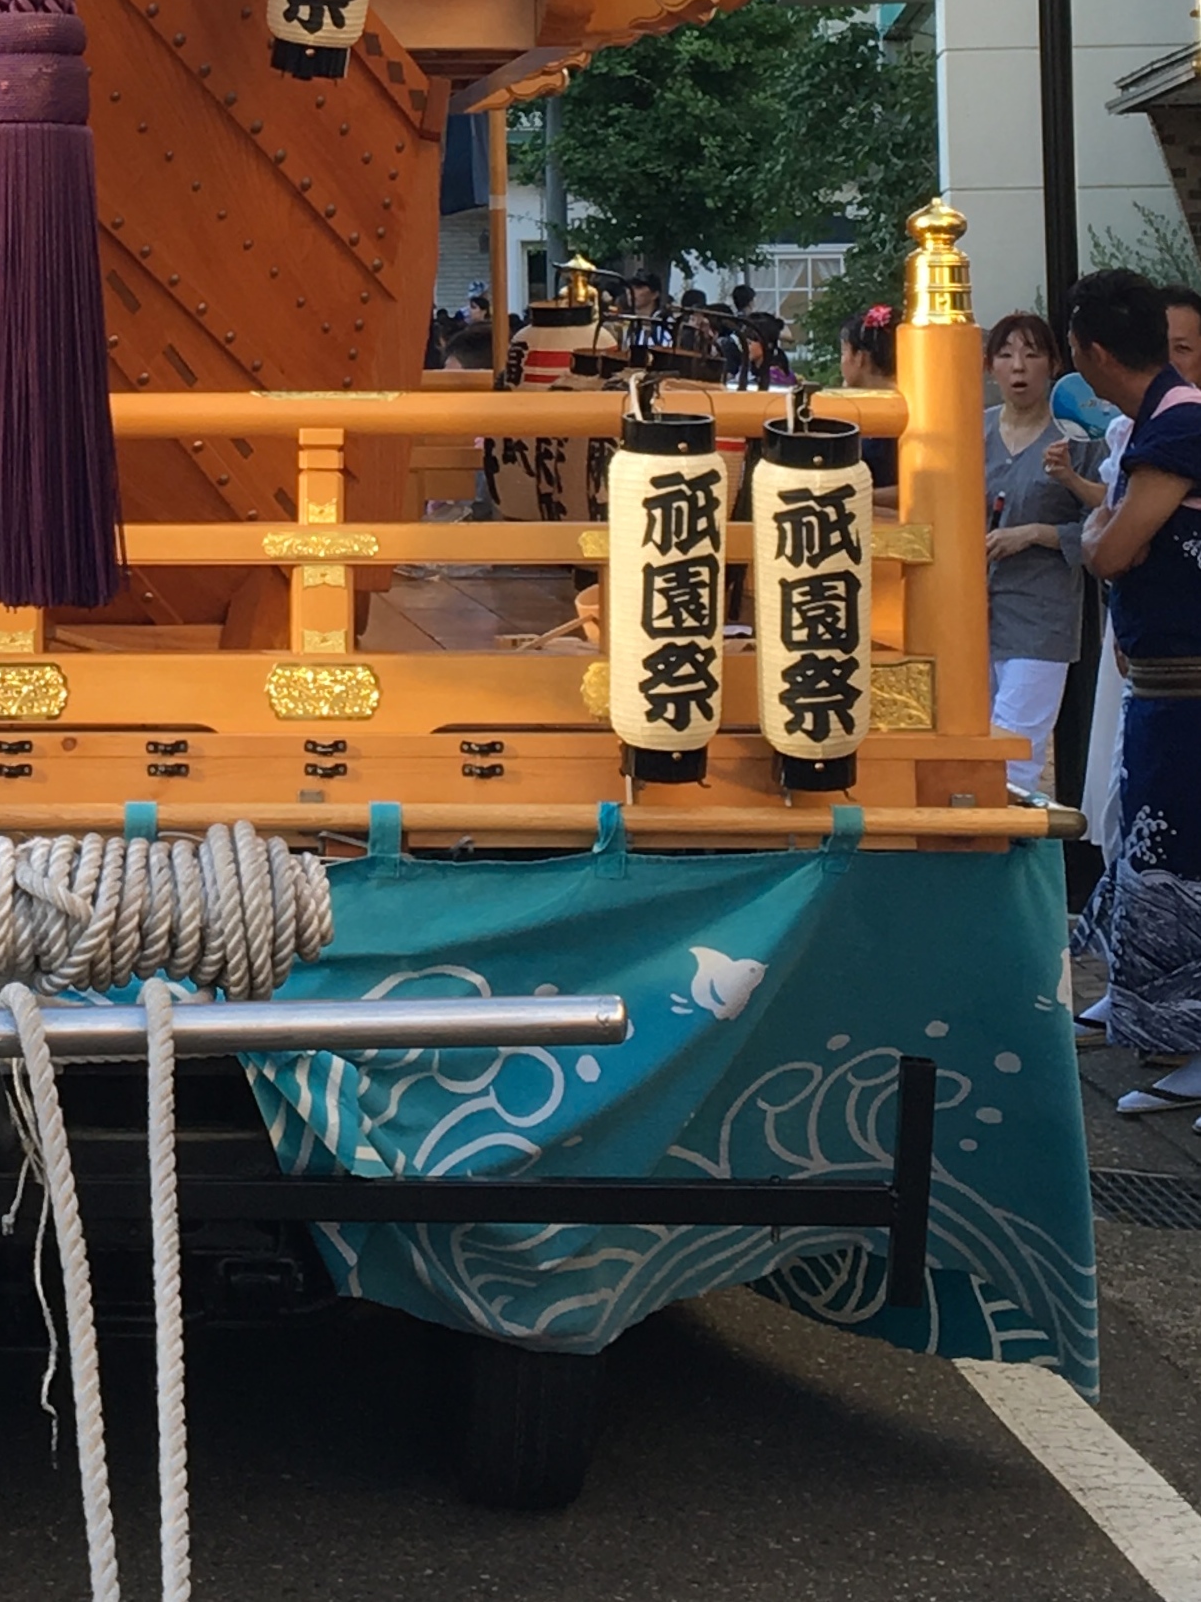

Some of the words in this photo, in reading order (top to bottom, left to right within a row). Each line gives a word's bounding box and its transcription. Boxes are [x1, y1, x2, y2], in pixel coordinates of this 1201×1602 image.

[640, 469, 722, 730] 祇園祭
[772, 484, 863, 742] 祇園祭
